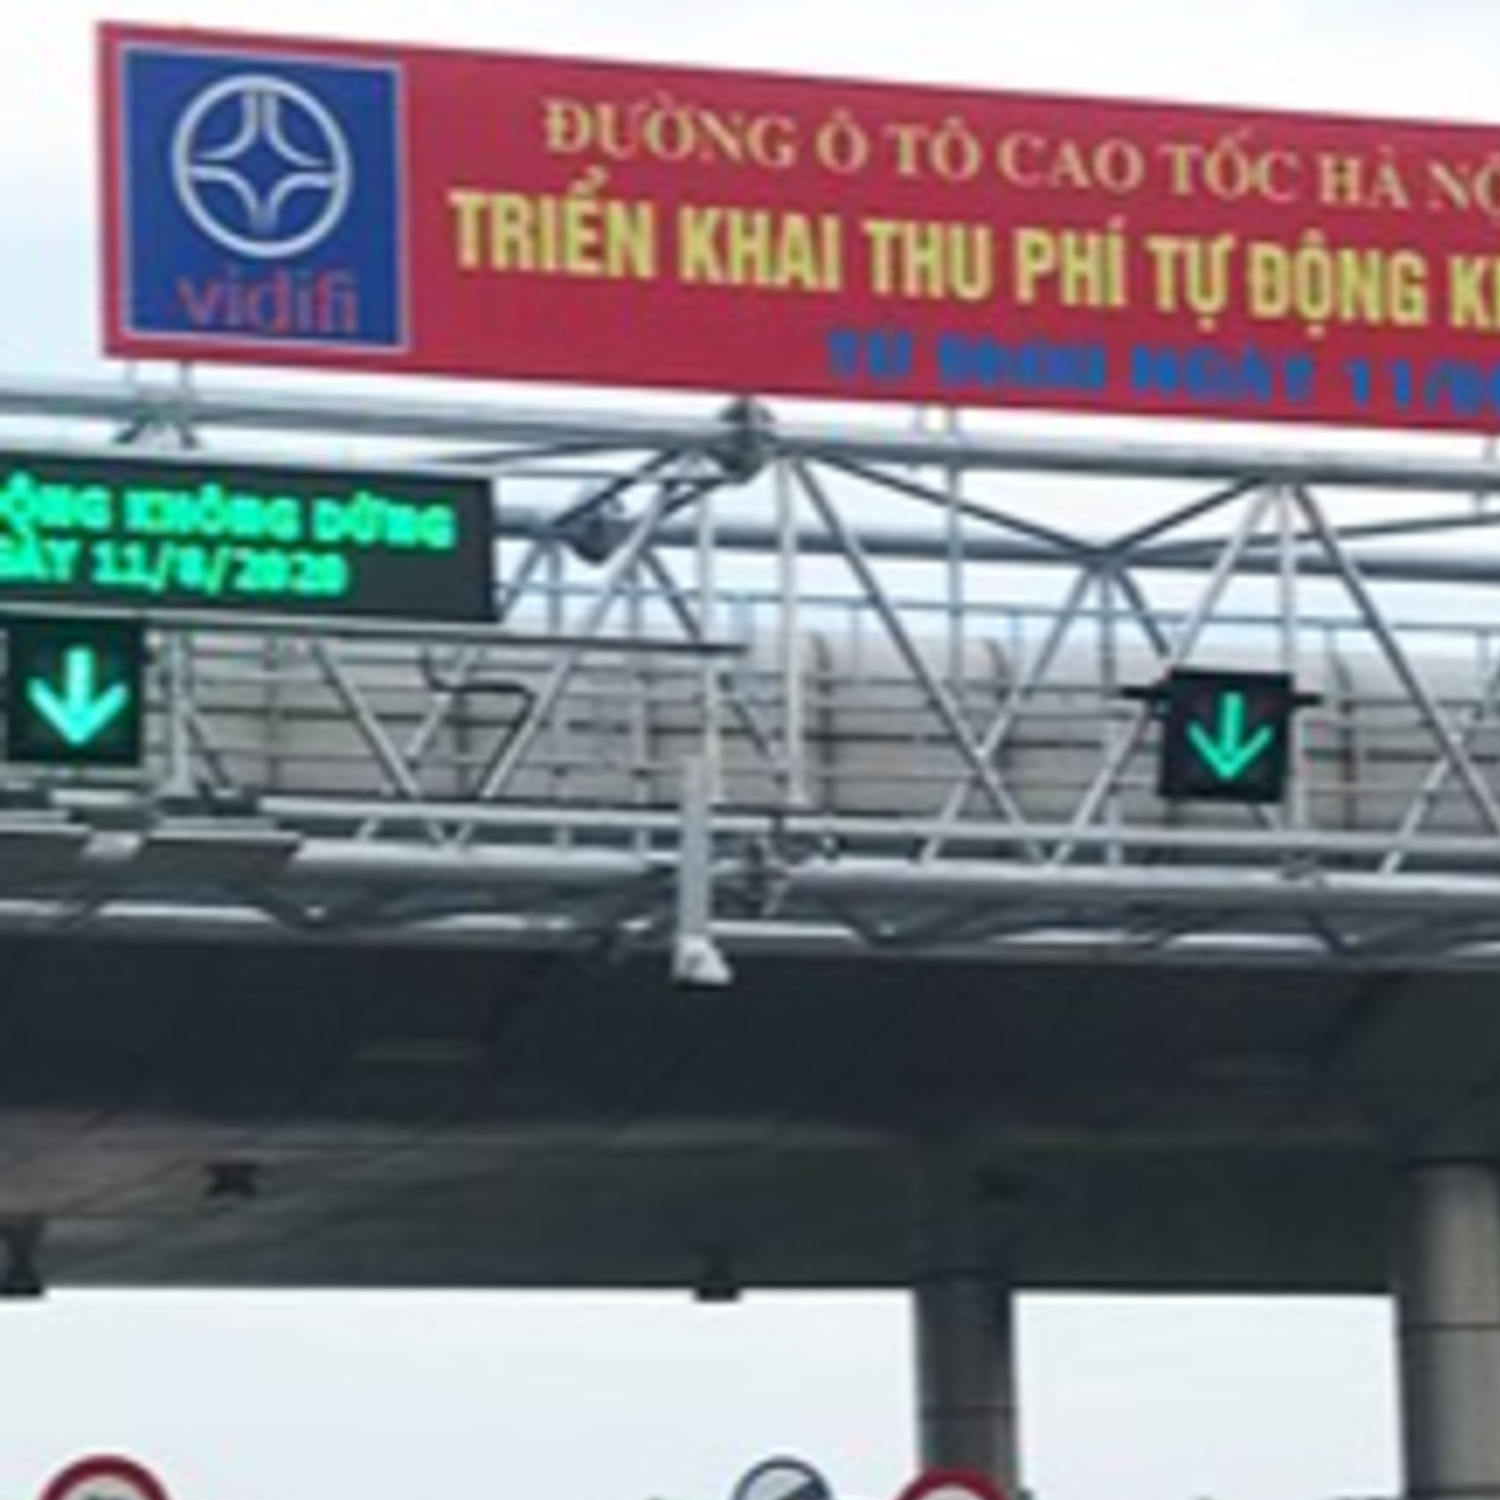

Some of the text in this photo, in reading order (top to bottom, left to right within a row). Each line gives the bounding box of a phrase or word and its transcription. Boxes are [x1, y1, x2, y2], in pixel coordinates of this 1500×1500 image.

[816, 109, 868, 174] Ô
[888, 117, 983, 183] TÔ
[996, 134, 1146, 194] CAO
[1319, 143, 1408, 209] HÀ
[448, 166, 655, 282] TRIỂN
[679, 211, 841, 292] KHAI
[863, 219, 990, 301] THU
[1015, 211, 1128, 309] PHÍ
[1147, 231, 1236, 332] TỰ
[1247, 228, 1429, 340] ĐỘNG
[174, 265, 358, 333] vidifi
[0, 472, 110, 534] ỘNG
